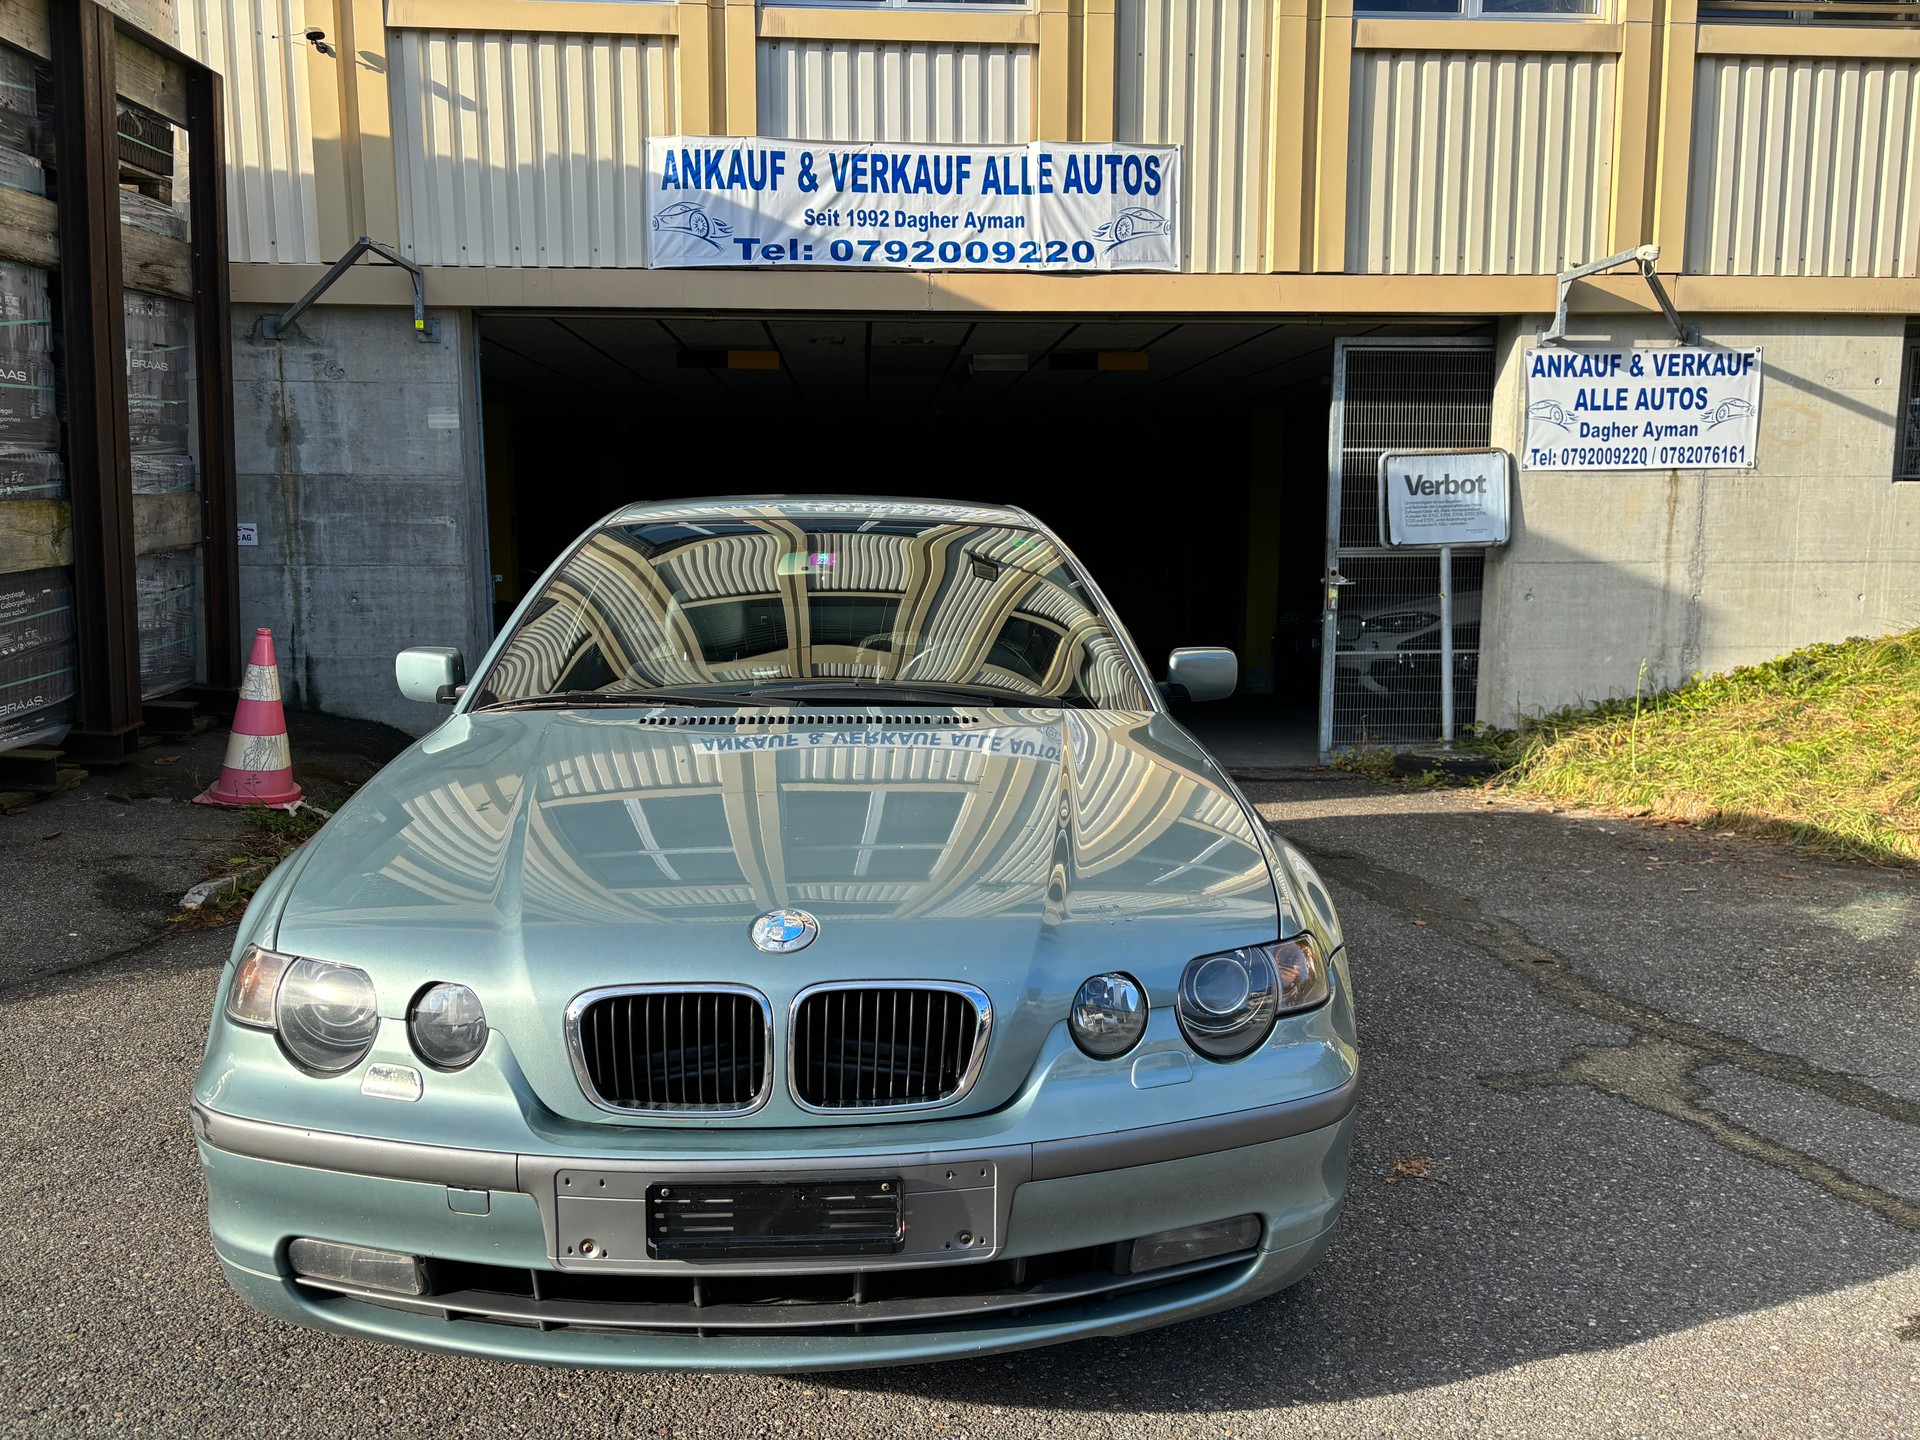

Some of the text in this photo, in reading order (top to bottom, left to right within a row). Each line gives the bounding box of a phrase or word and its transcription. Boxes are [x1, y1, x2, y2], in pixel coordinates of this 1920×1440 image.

[661, 149, 1161, 196] ANKAUF & VERKAUF ALLE AUTOS
[803, 208, 1026, 234] Seit 1992 Dagher Ayman
[733, 237, 1095, 264] Tel: 0792009220
[131, 359, 169, 372] BRAAS
[1531, 352, 1754, 378] ANKAUF & VERKAUF
[1574, 386, 1708, 412] ALLE AUTOS
[1579, 421, 1699, 442] Dagher Ayman
[1531, 448, 1557, 466] Tel:
[1561, 446, 1648, 466] 0792009220
[1660, 445, 1746, 464] 0782076161
[1403, 473, 1487, 496] Verbot
[241, 533, 252, 542] AG
